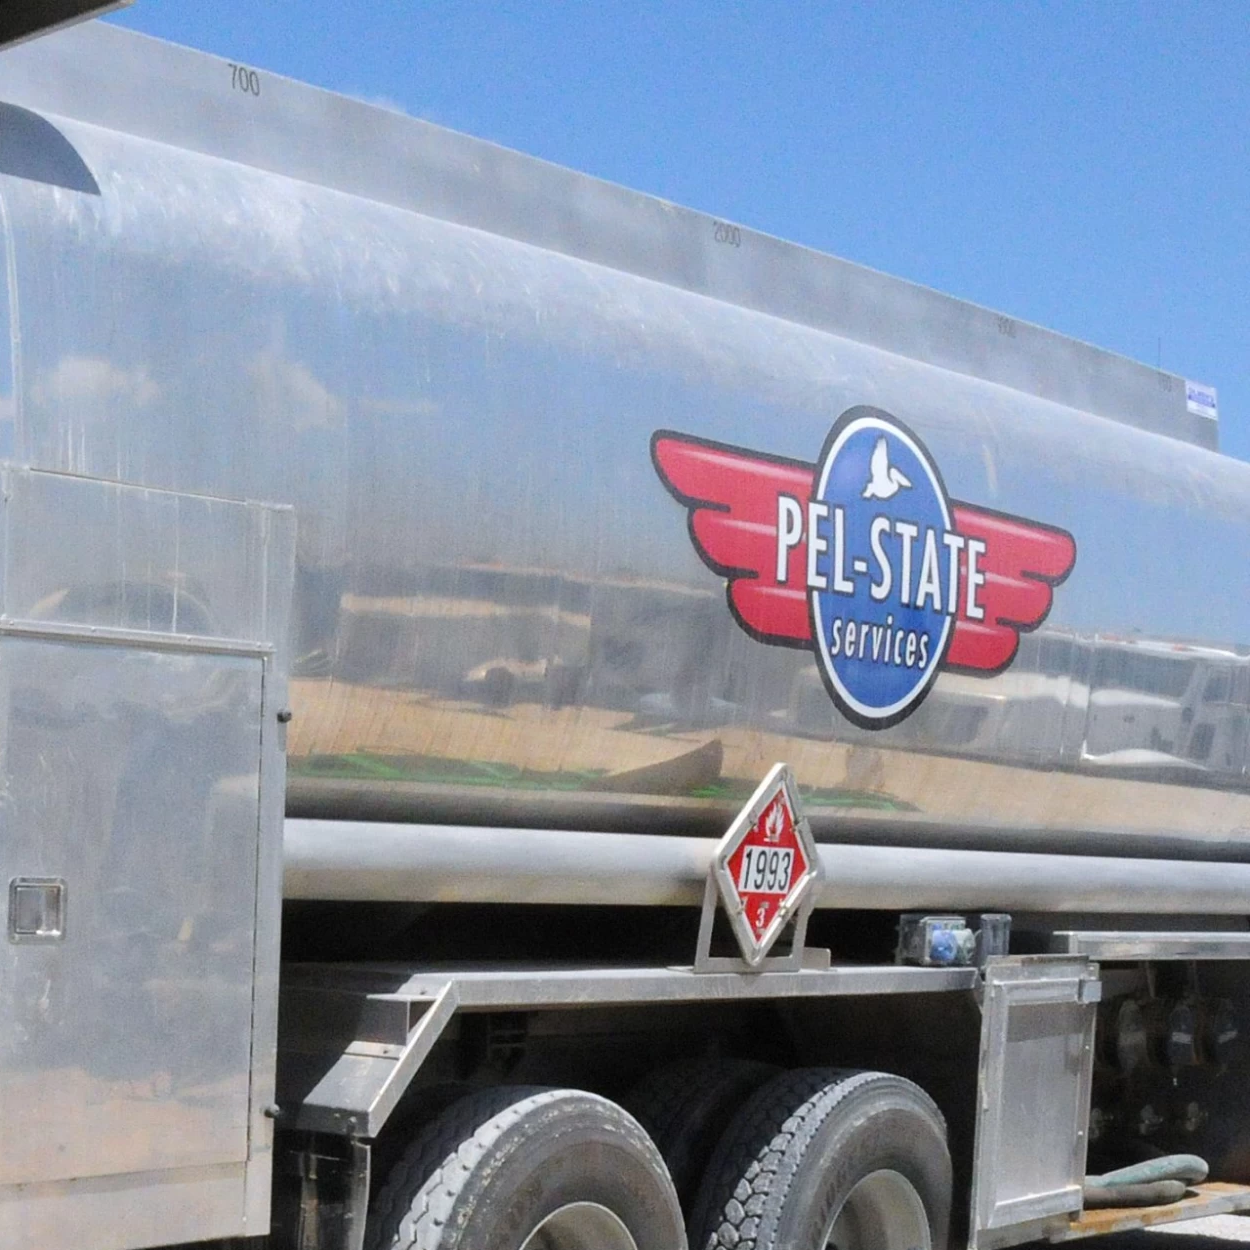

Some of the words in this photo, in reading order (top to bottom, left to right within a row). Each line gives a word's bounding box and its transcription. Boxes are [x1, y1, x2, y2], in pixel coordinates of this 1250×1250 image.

[227, 63, 260, 97] 700
[776, 495, 987, 619] PEL-STATE
[830, 615, 930, 669] services
[743, 848, 791, 891] 1993
[755, 906, 766, 927] 3
